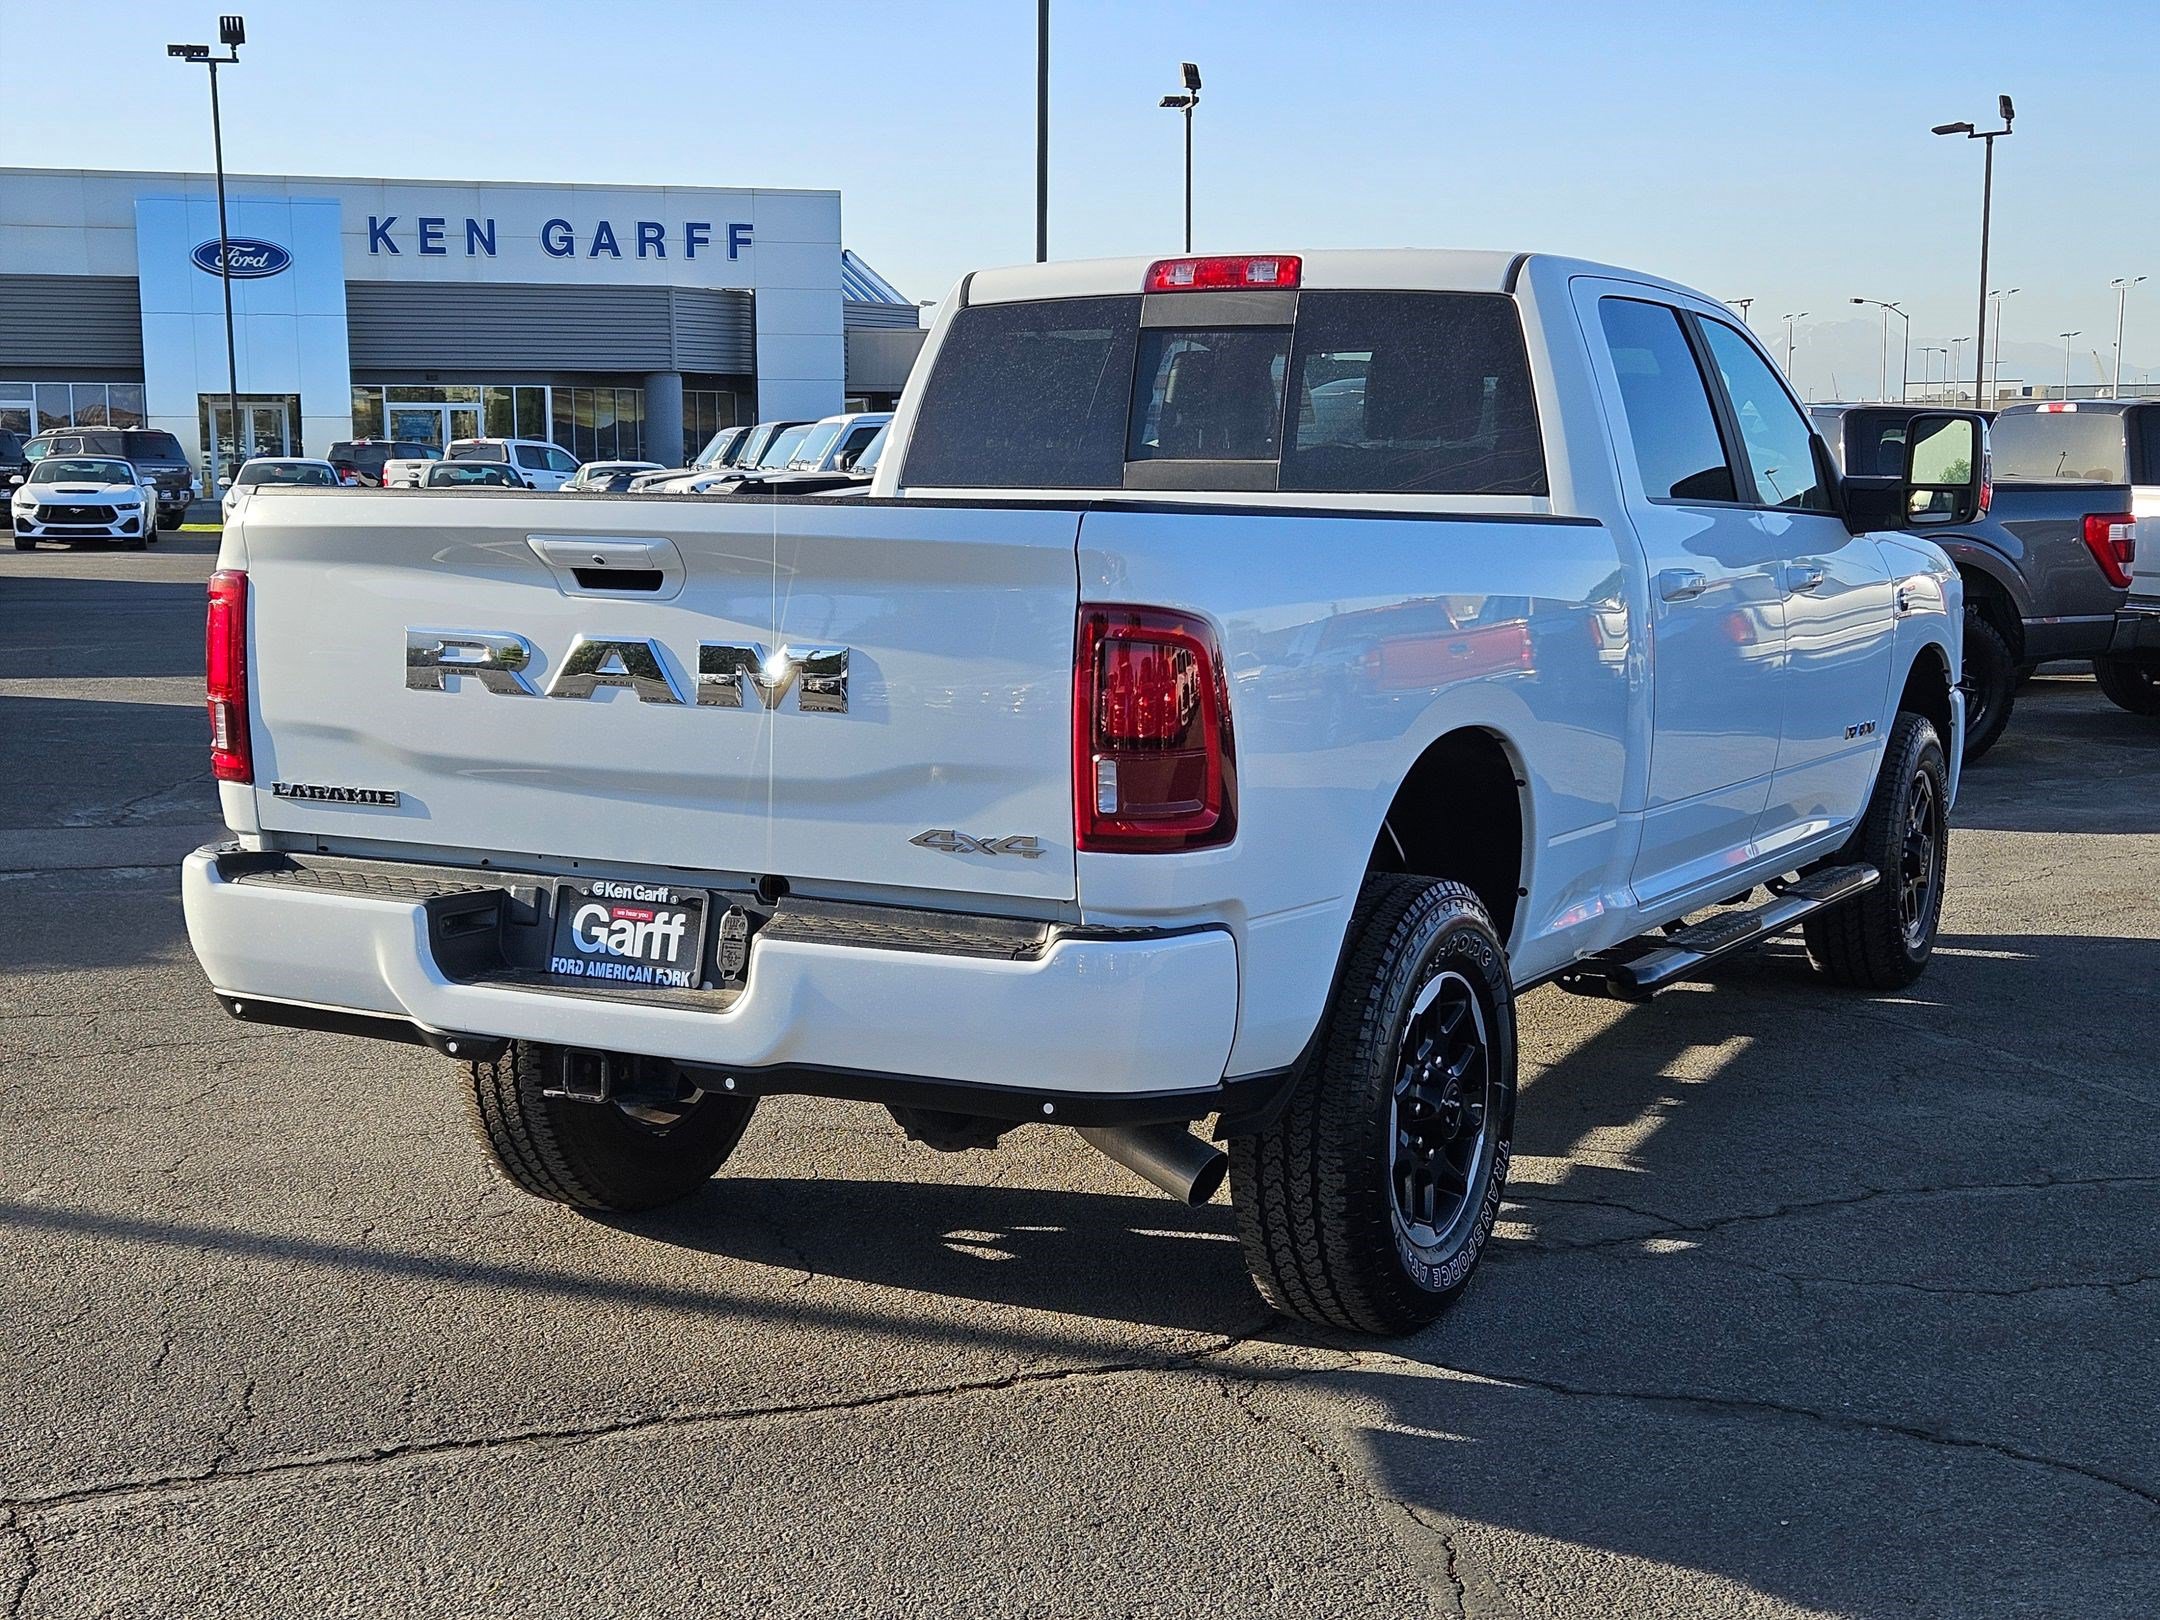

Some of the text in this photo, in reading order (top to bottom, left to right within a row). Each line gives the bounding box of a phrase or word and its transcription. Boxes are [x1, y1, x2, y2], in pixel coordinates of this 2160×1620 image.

[214, 245, 270, 268] Ford
[367, 214, 755, 261] KEN GARFF
[404, 625, 849, 714] RAM
[271, 781, 400, 808] LARAMIE
[604, 881, 669, 903] Ken Garff
[572, 903, 686, 962] Garff
[551, 957, 692, 987] FORD AMERICAN FORK
[1433, 1140, 1510, 1287] TRANSFORCE
